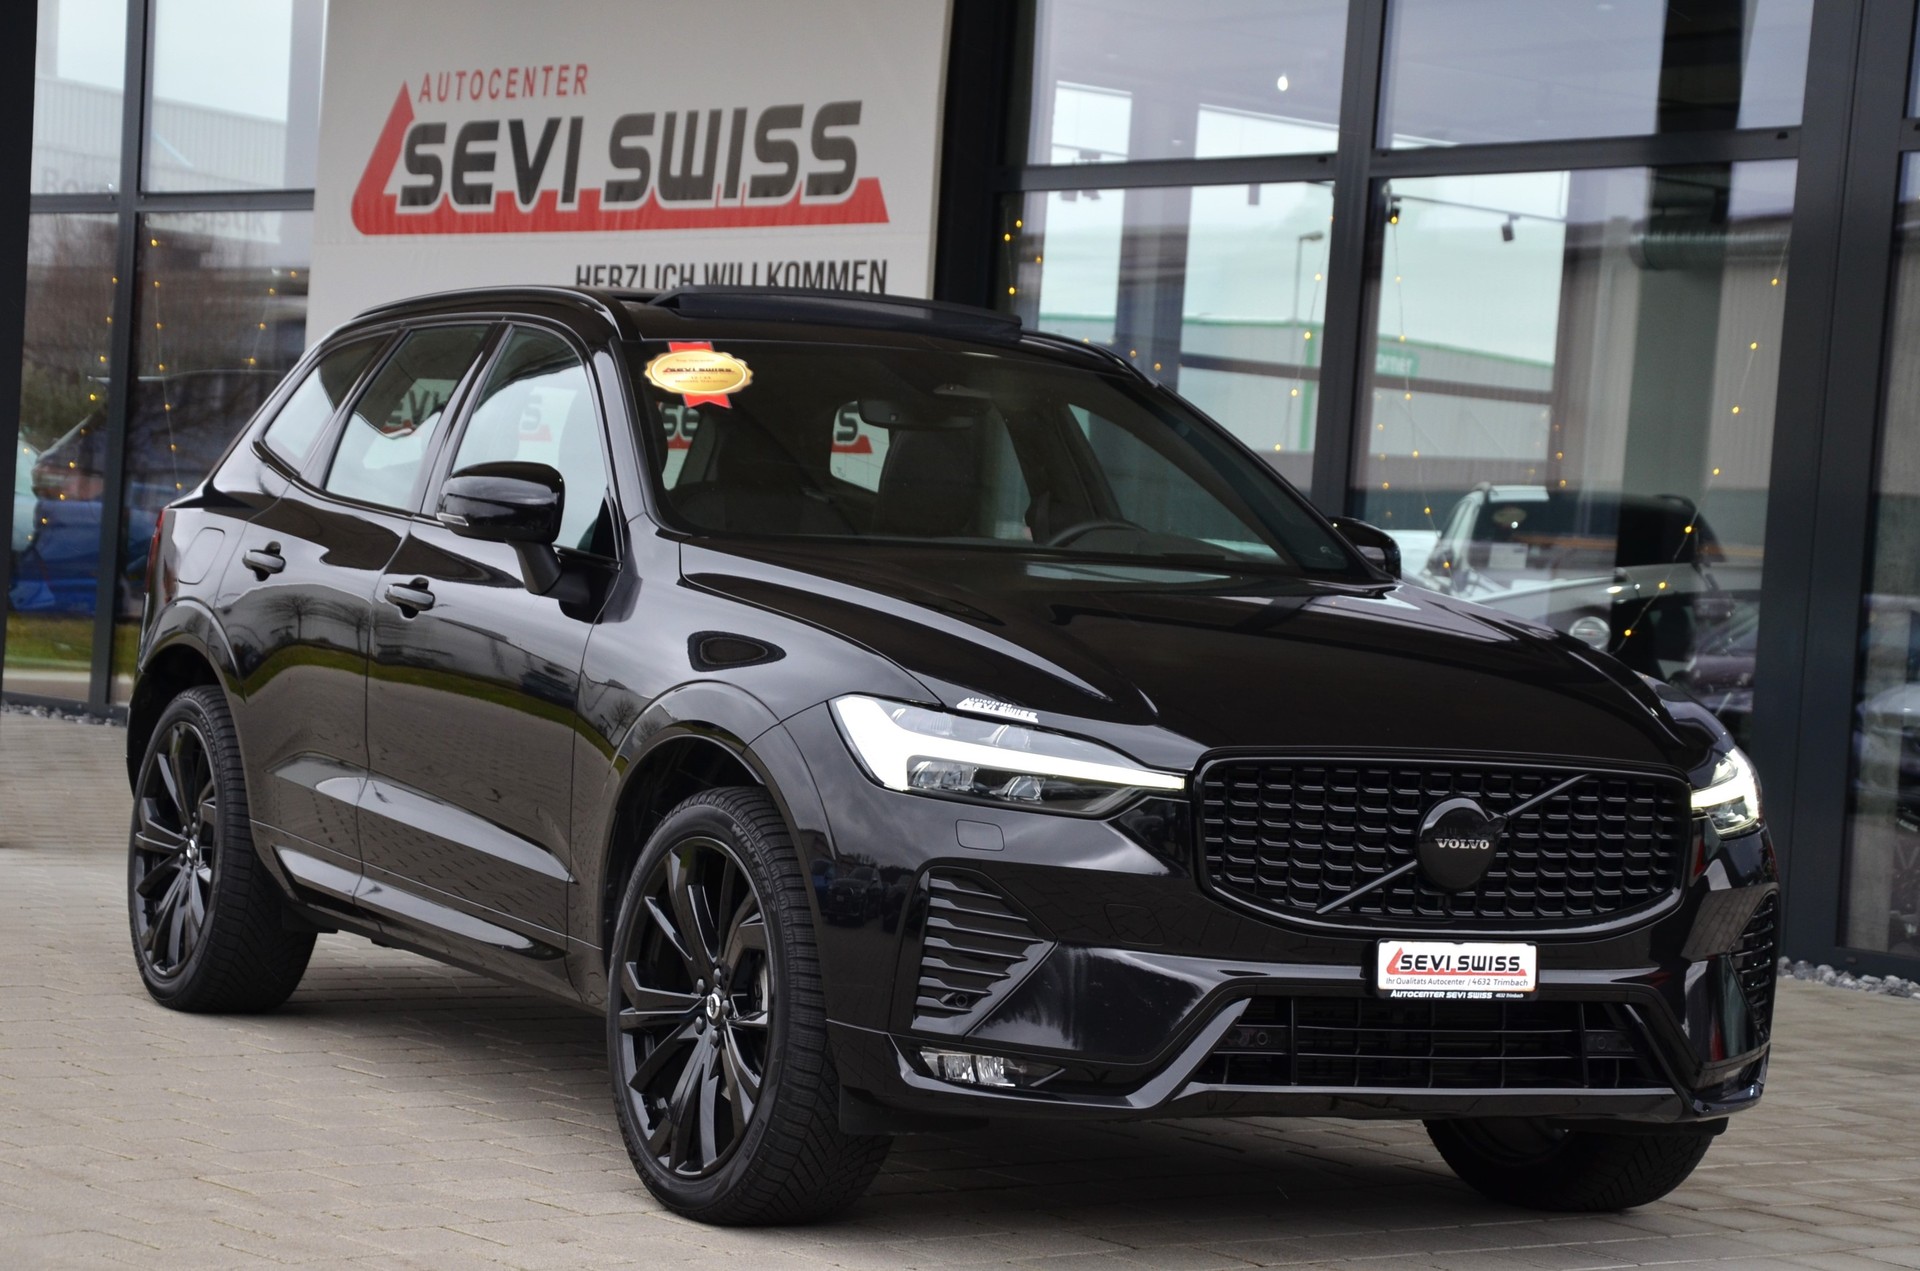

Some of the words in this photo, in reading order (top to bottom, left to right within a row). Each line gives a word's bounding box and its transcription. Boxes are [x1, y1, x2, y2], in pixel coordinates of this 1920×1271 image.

[418, 64, 589, 103] AUTOCENTER
[400, 116, 584, 207] SEVI
[604, 100, 863, 204] SWISS
[1435, 838, 1490, 850] VOLVO
[1400, 954, 1451, 971] SEVI
[1457, 955, 1520, 972] SWISS
[1428, 978, 1466, 986] Autocenter
[1472, 978, 1491, 986] 4632
[1493, 978, 1528, 987] Trimbach
